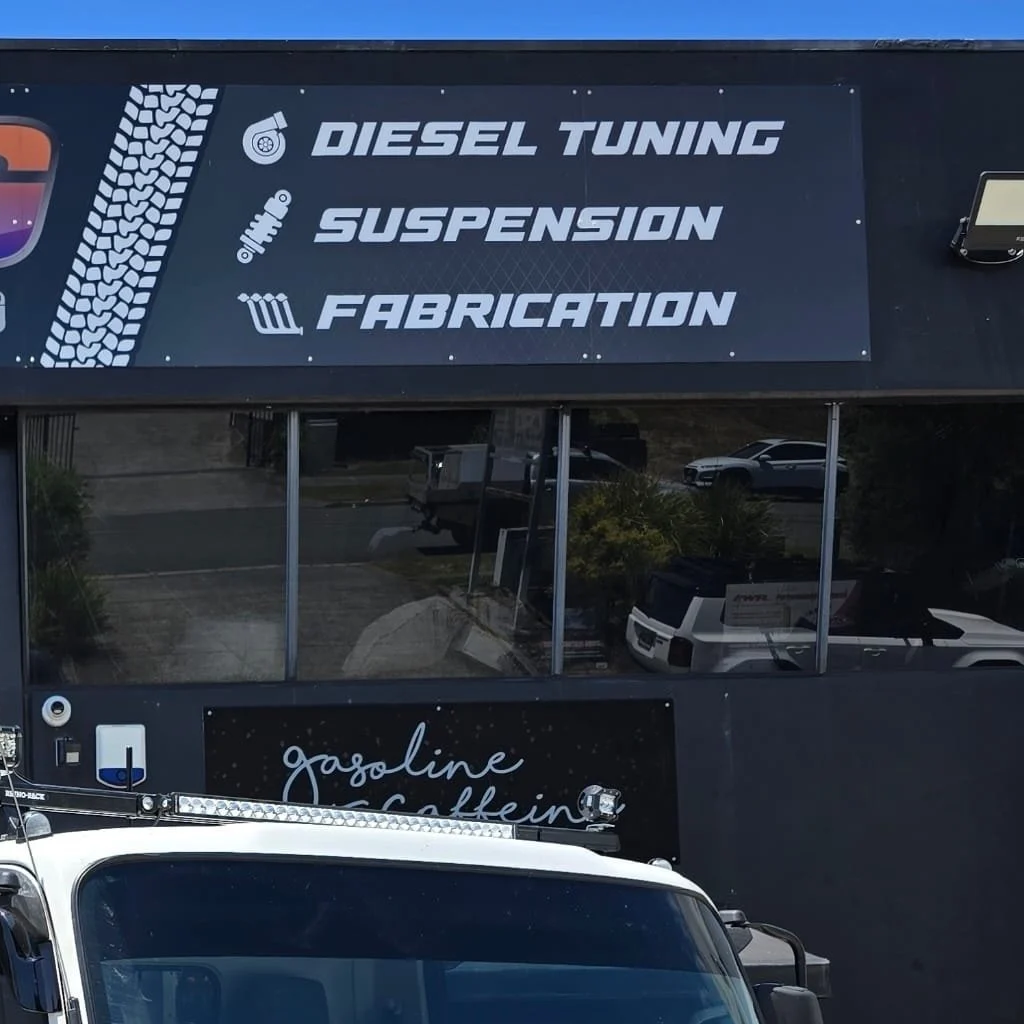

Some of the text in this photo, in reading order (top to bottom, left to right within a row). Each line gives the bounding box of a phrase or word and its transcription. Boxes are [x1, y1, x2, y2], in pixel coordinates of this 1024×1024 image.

[310, 120, 785, 157] DIESEL TUNING
[314, 205, 723, 243] SUSPENSION
[316, 291, 737, 330] FABRICATION
[283, 722, 524, 804] gasoline
